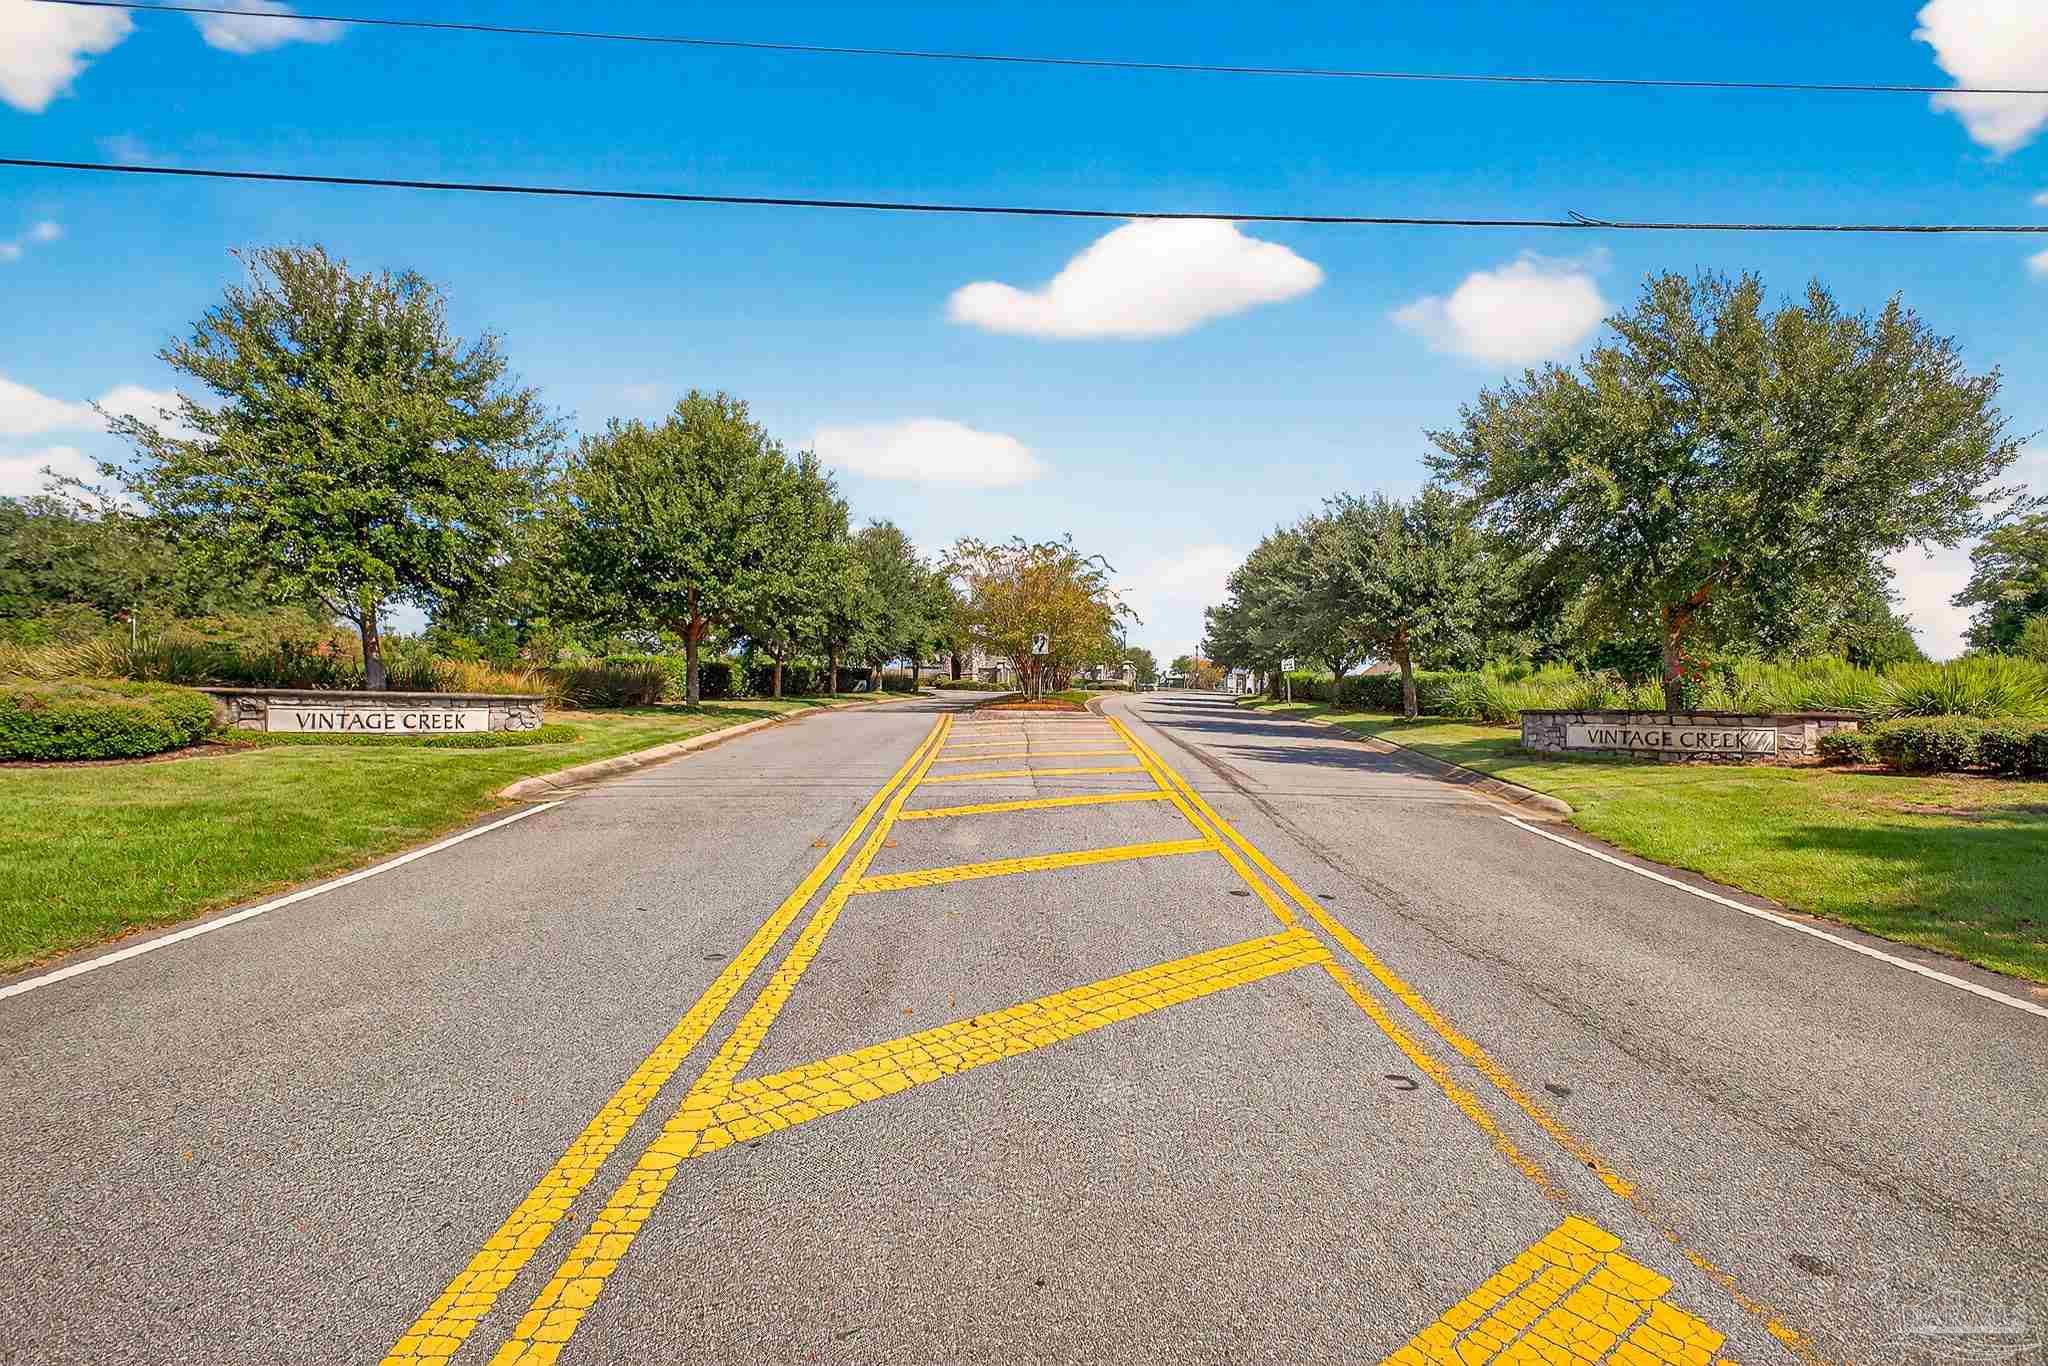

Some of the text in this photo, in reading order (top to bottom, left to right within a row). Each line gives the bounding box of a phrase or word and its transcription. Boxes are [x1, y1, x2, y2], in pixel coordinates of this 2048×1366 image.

[296, 713, 466, 730] VINTAGE CREEK
[1587, 729, 1748, 749] VINTAGE CREEK
